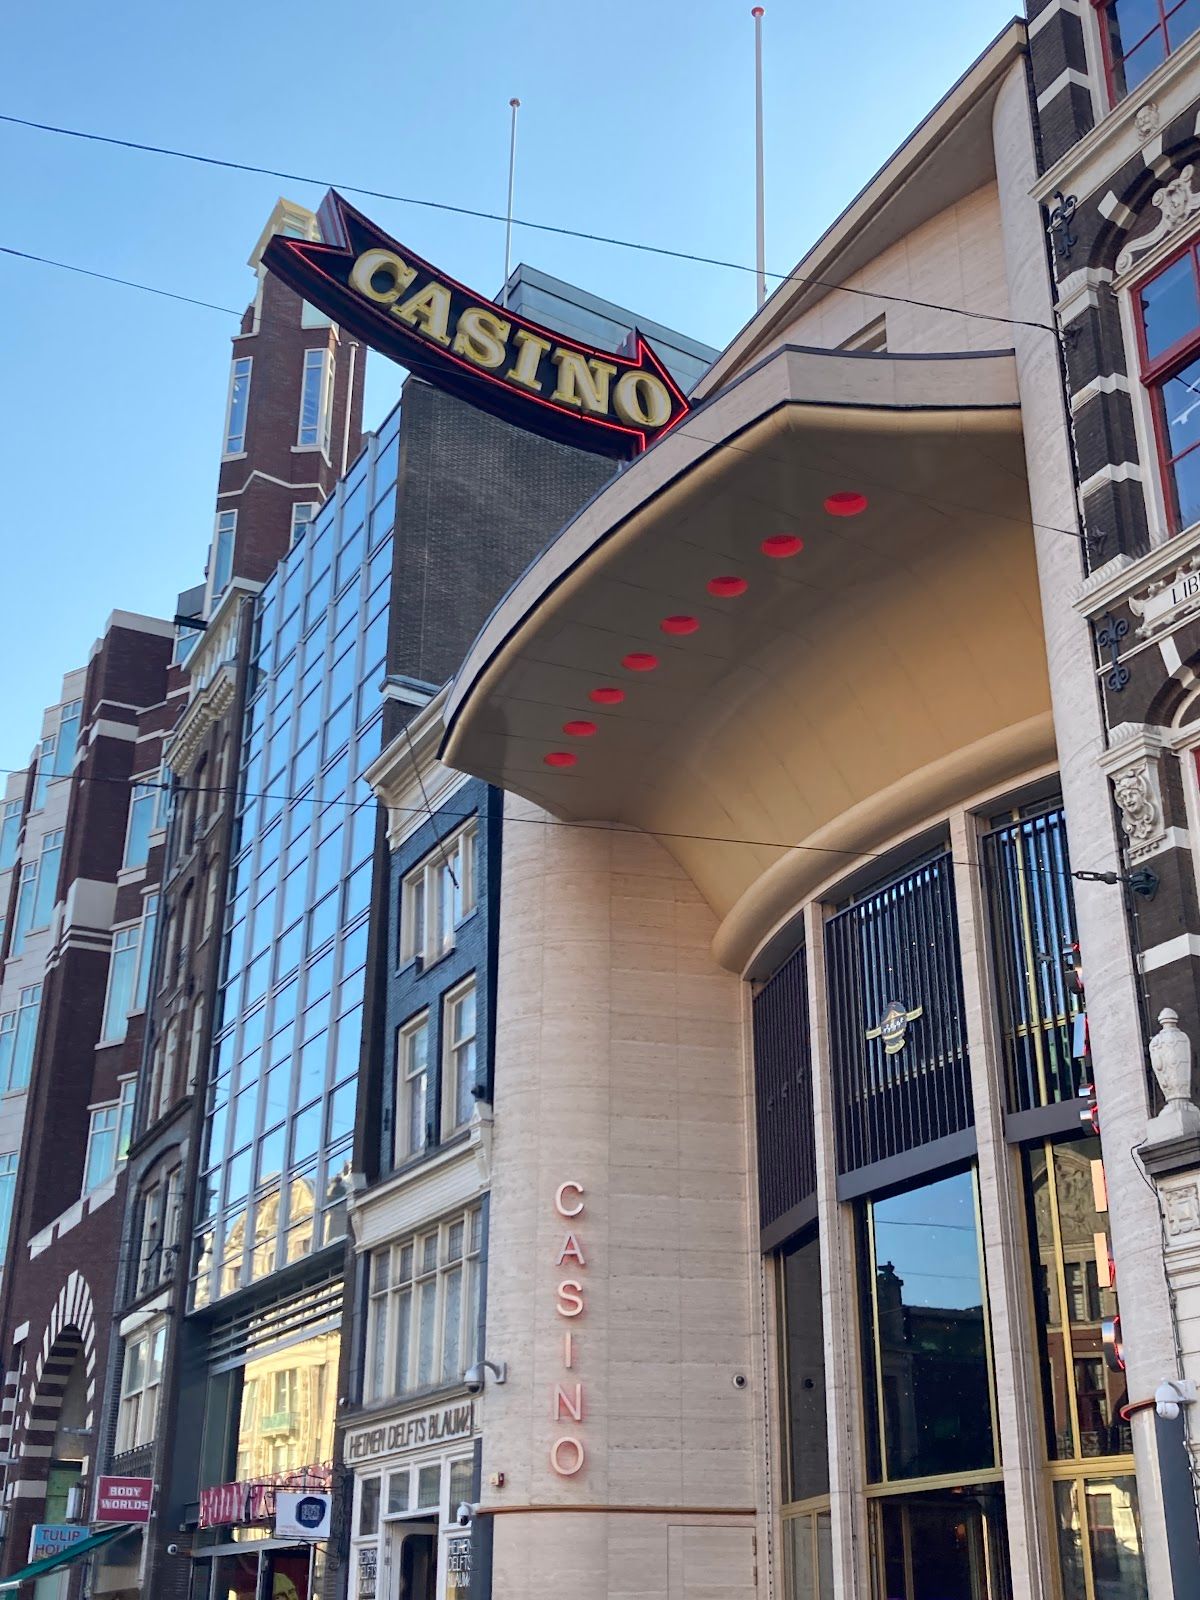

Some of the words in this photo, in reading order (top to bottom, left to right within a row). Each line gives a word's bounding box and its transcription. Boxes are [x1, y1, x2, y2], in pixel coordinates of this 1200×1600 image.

[348, 247, 672, 429] CASINO
[1171, 572, 1200, 604] LIB
[553, 1180, 585, 1476] CASINO
[388, 1416, 427, 1450] DELFTS
[101, 1499, 149, 1510] WORLDS
[109, 1486, 142, 1497] BODY
[40, 1529, 81, 1541] TULIP
